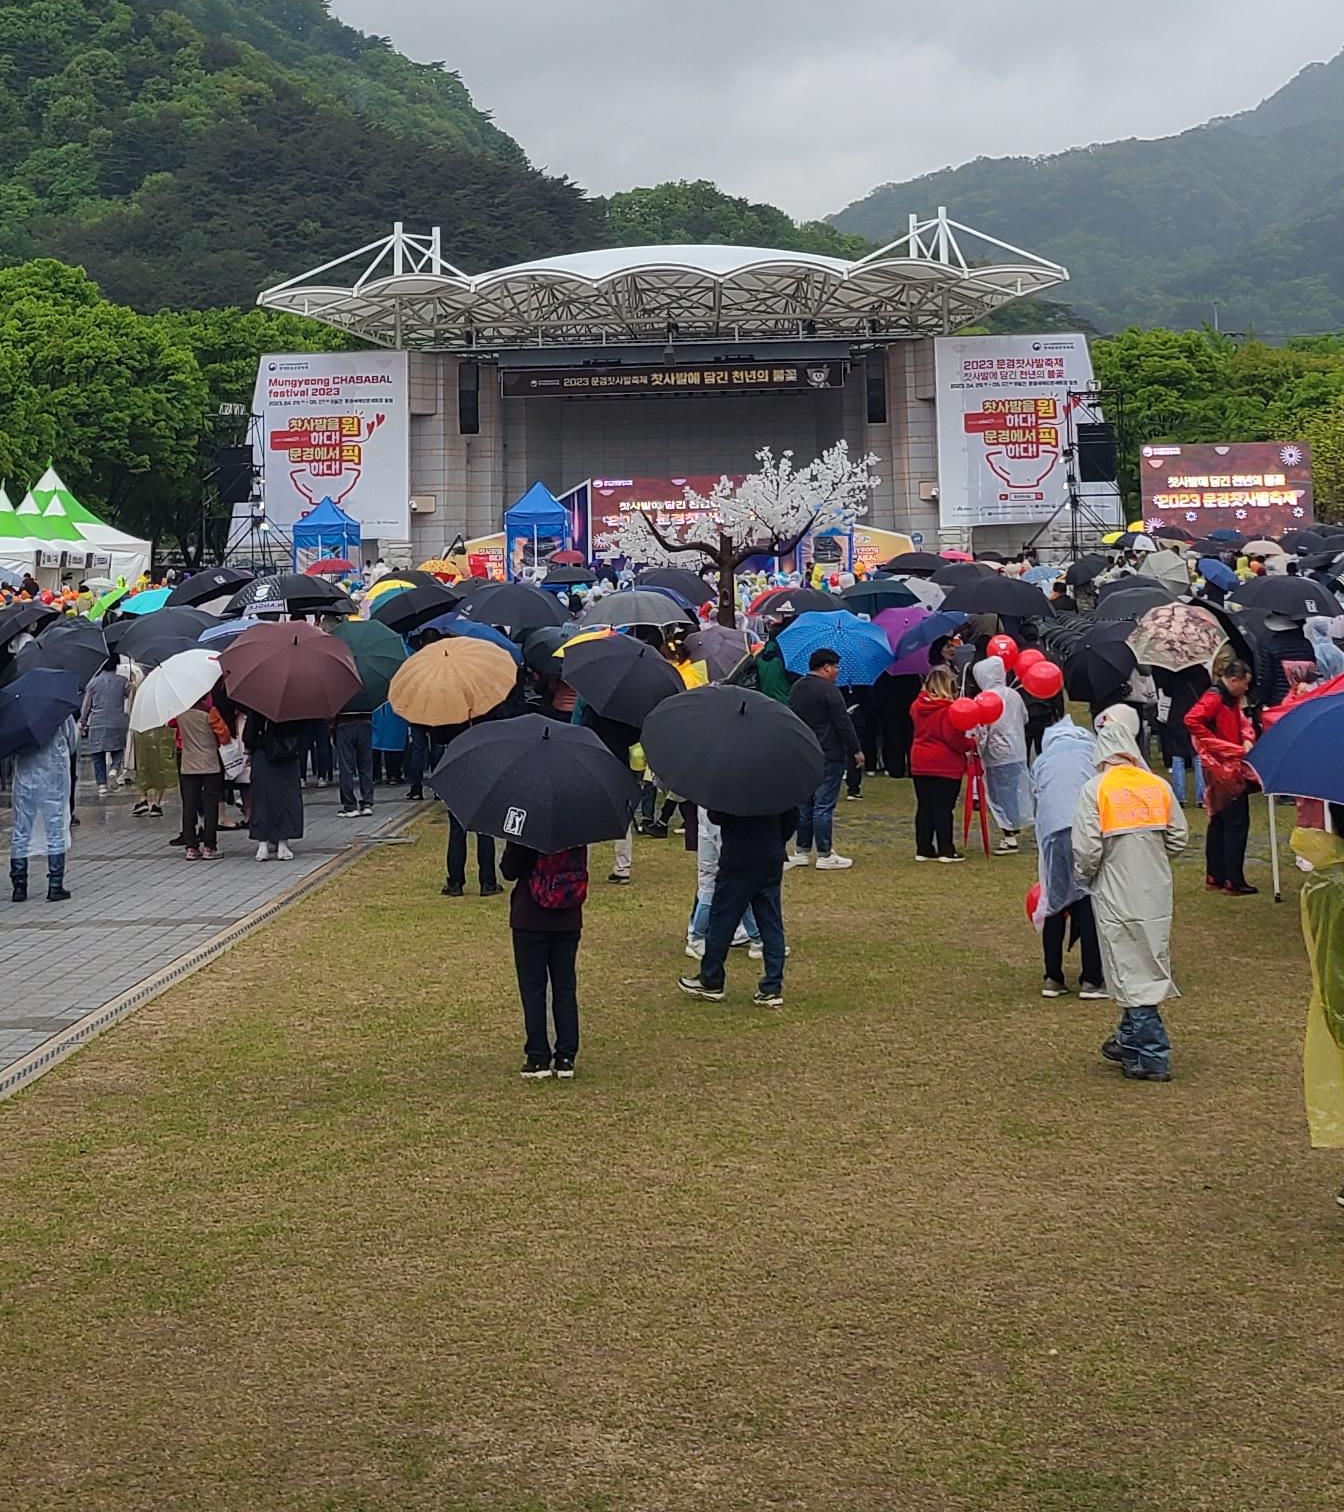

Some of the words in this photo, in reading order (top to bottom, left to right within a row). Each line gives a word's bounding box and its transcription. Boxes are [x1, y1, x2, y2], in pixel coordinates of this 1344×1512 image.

[964, 360, 994, 370] 2023
[268, 377, 330, 388] Mungyeong
[564, 377, 588, 387] 2023
[703, 371, 729, 384] 담긴
[732, 370, 769, 384] 천년의
[1000, 370, 1017, 380] 담긴
[268, 388, 309, 398] festival
[311, 387, 340, 396] 2023
[982, 400, 1035, 414] 찻사발을
[1036, 399, 1055, 417] 원
[289, 418, 340, 431] 찻사발을
[341, 417, 359, 435] 원
[1006, 414, 1036, 427] 하다!
[984, 429, 1036, 443] 문경에서
[1038, 428, 1056, 445] 픽
[289, 446, 340, 461] 문경에서
[342, 445, 359, 463] 픽
[1007, 444, 1037, 457] 하다!
[1158, 492, 1201, 509] 2023
[1203, 490, 1299, 508] 문경찻사발축제
